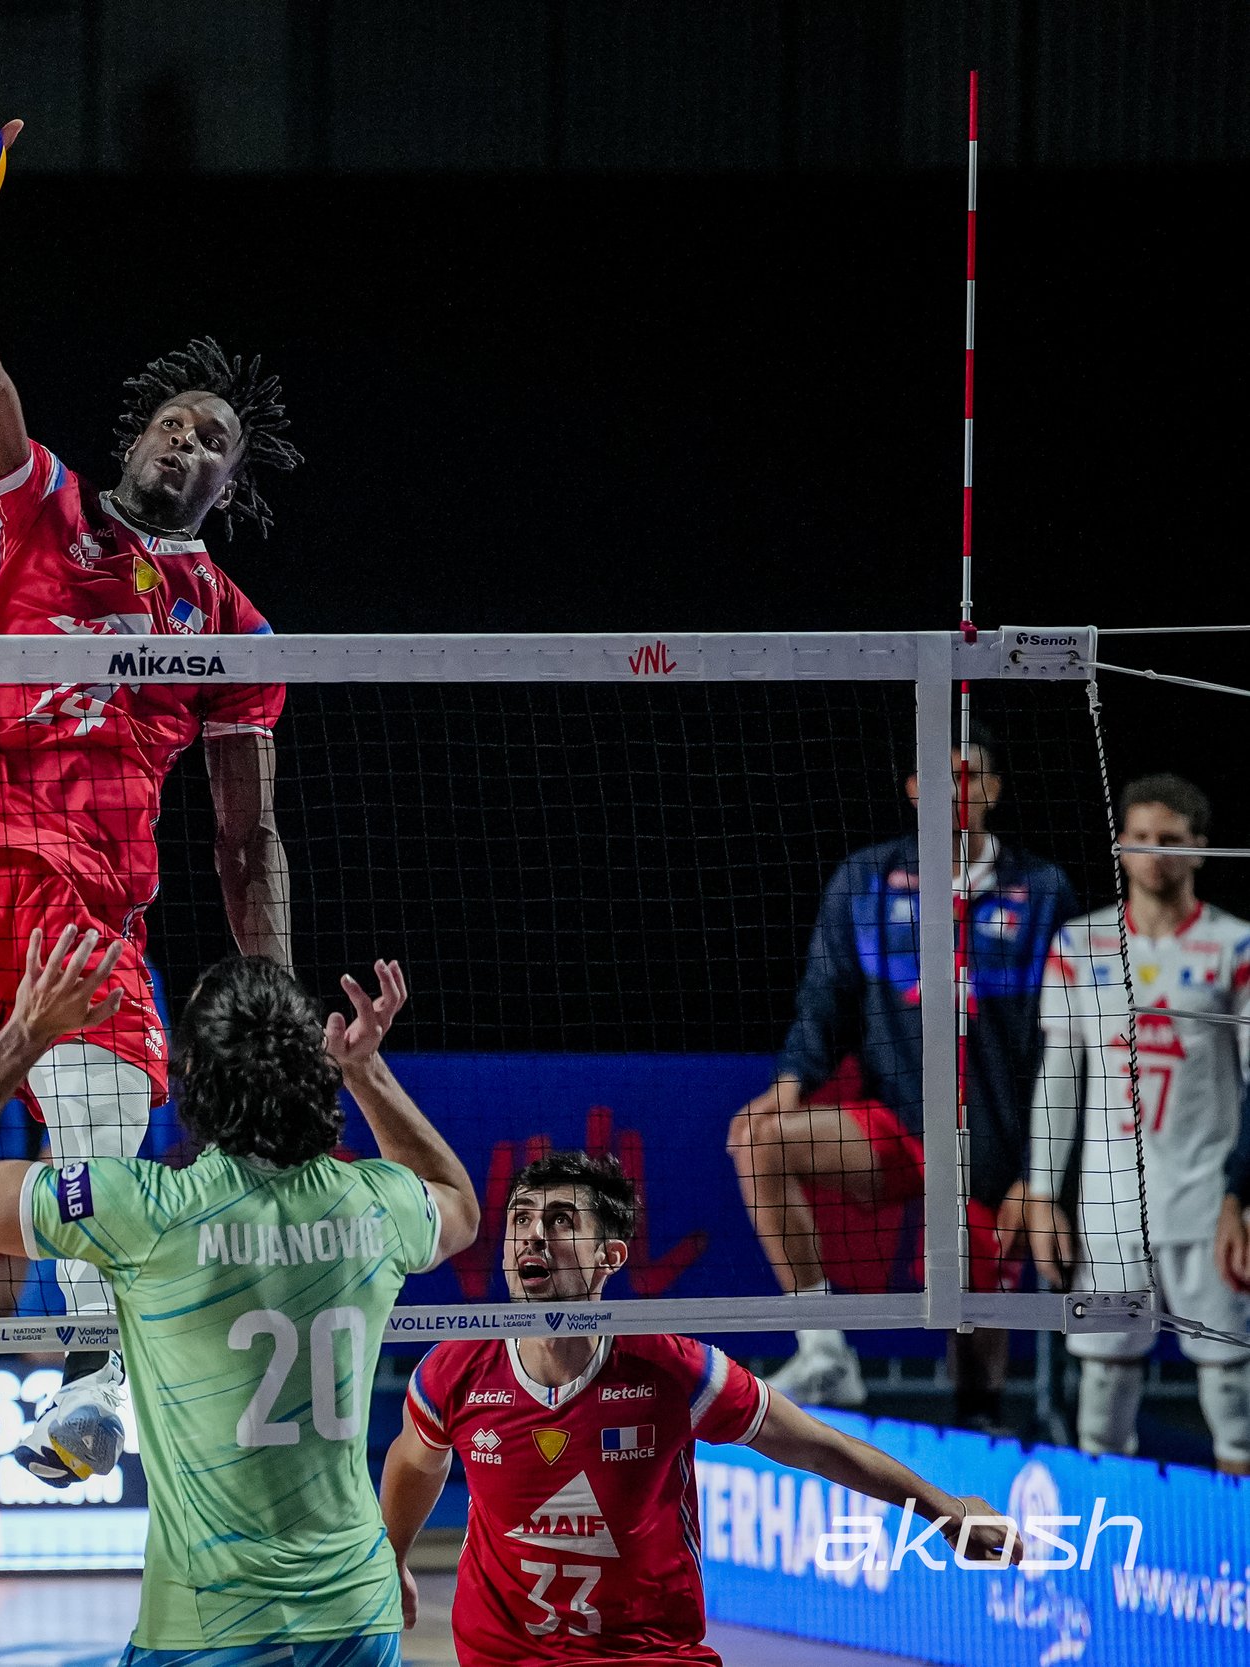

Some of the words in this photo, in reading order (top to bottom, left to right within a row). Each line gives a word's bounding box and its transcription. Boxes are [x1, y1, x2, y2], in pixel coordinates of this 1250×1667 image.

[1030, 635, 1077, 646] Senoh
[628, 640, 677, 676] VNL
[66, 1181, 84, 1217] NLB
[390, 1315, 500, 1331] VOLLEYBALL
[503, 1313, 537, 1321] NATIONS
[503, 1320, 532, 1328] LEAGUE
[566, 1312, 612, 1323] Volleyball
[13, 1327, 47, 1335] NATIONS
[78, 1326, 119, 1336] Volleyba
[566, 1321, 597, 1331] World
[78, 1335, 109, 1345] World
[227, 1305, 370, 1448] 20
[467, 1390, 513, 1404] Betclic
[601, 1384, 653, 1401] Betclic
[470, 1450, 502, 1465] errea
[601, 1447, 655, 1462] FRANCE
[522, 1514, 605, 1537] MAIF
[520, 1558, 602, 1637] 33
